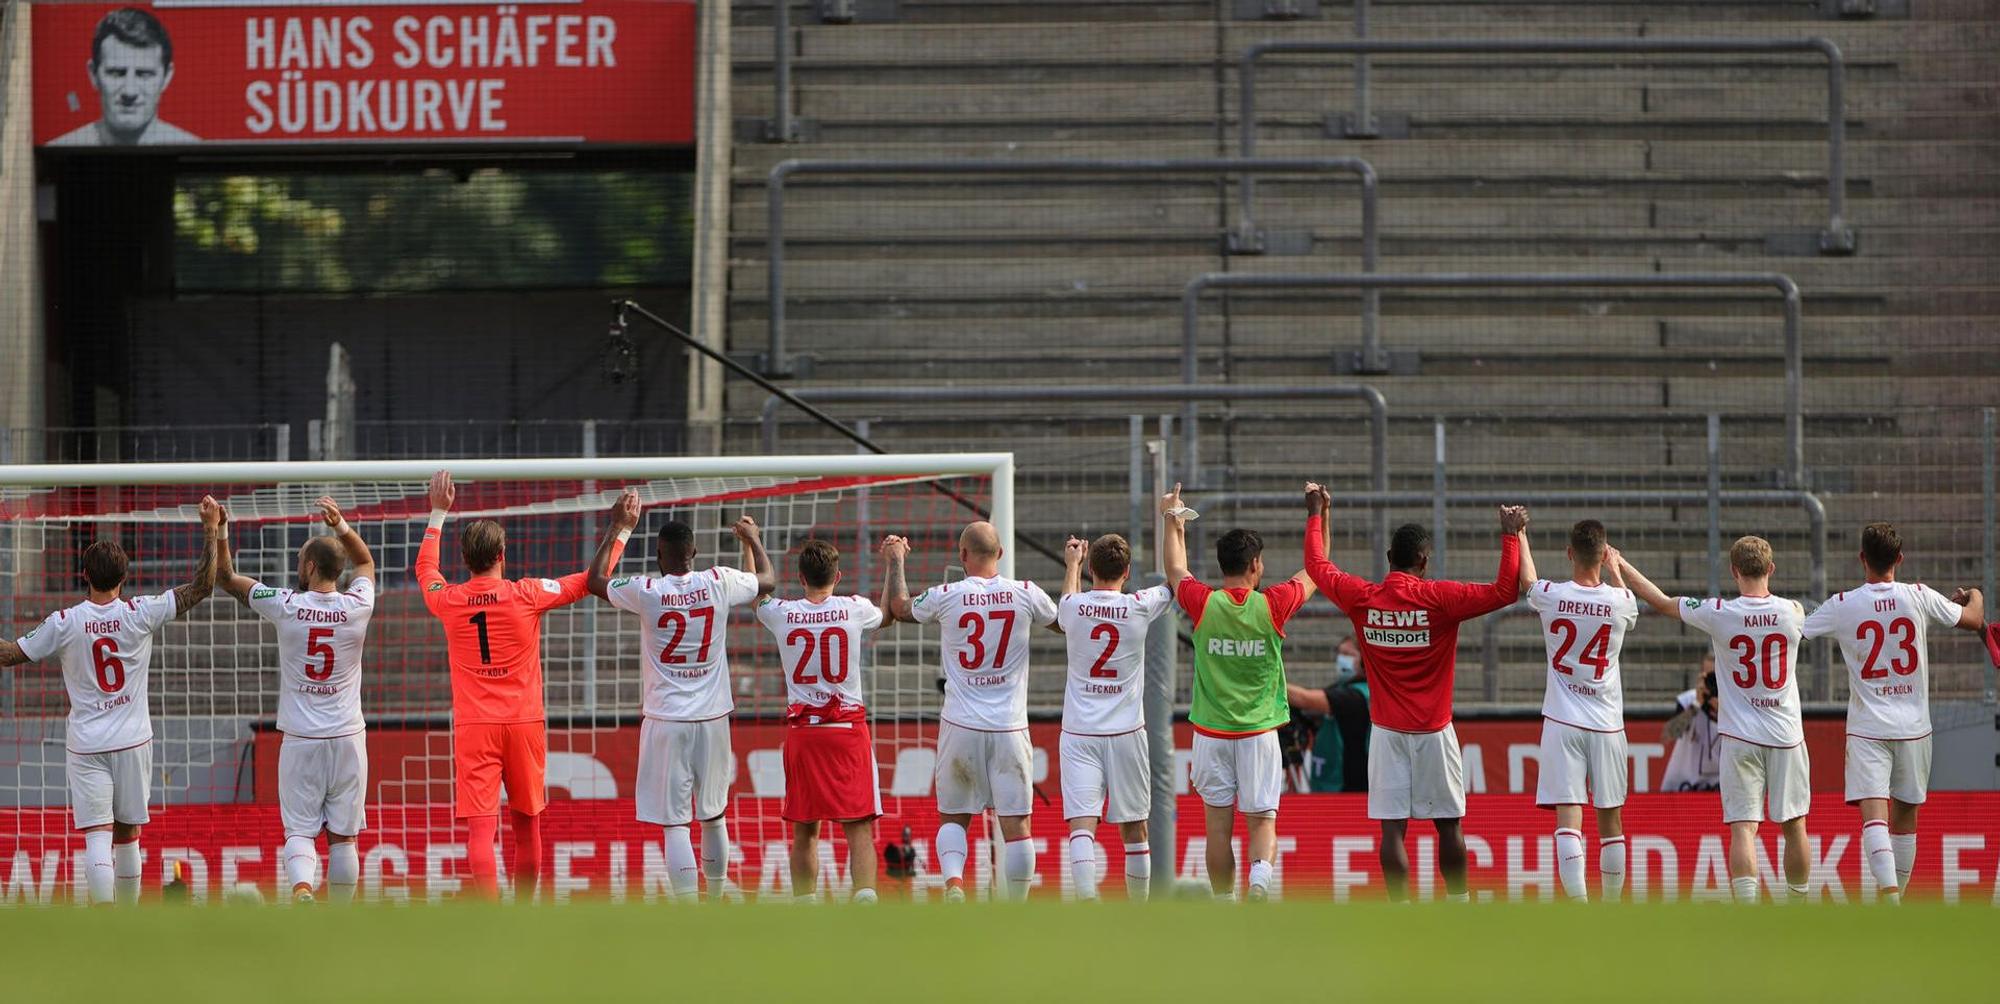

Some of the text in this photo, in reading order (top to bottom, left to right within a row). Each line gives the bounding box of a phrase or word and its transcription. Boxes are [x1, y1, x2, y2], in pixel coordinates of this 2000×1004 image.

[246, 5, 617, 70] HANS SCHÄFER
[246, 72, 506, 134] SÜDKURVE
[468, 593, 498, 606] HORN
[661, 588, 710, 606] MODESTE
[963, 591, 1014, 606] LEISTNER
[1874, 598, 1896, 612] UTH
[297, 608, 348, 623] CZICHOS
[1078, 604, 1128, 619] SCHMITZ
[1367, 608, 1430, 627] REWE
[1558, 600, 1612, 618] DREXLER
[1744, 614, 1778, 628] KAINZ
[469, 610, 491, 665] 1
[657, 605, 715, 664] 27
[958, 610, 1016, 670] 37
[1366, 629, 1429, 646] uhlsport
[305, 627, 335, 682] 5
[786, 626, 849, 685] 20
[1089, 623, 1120, 678] 2
[1208, 638, 1266, 657] REWE
[1549, 617, 1613, 680] 24
[1856, 616, 1919, 680] 23
[92, 637, 126, 694] 6
[1729, 633, 1788, 690] 30
[975, 676, 986, 685] FC
[1093, 684, 1103, 693] FC
[1883, 687, 1893, 696] FC
[1751, 697, 1760, 707] FC
